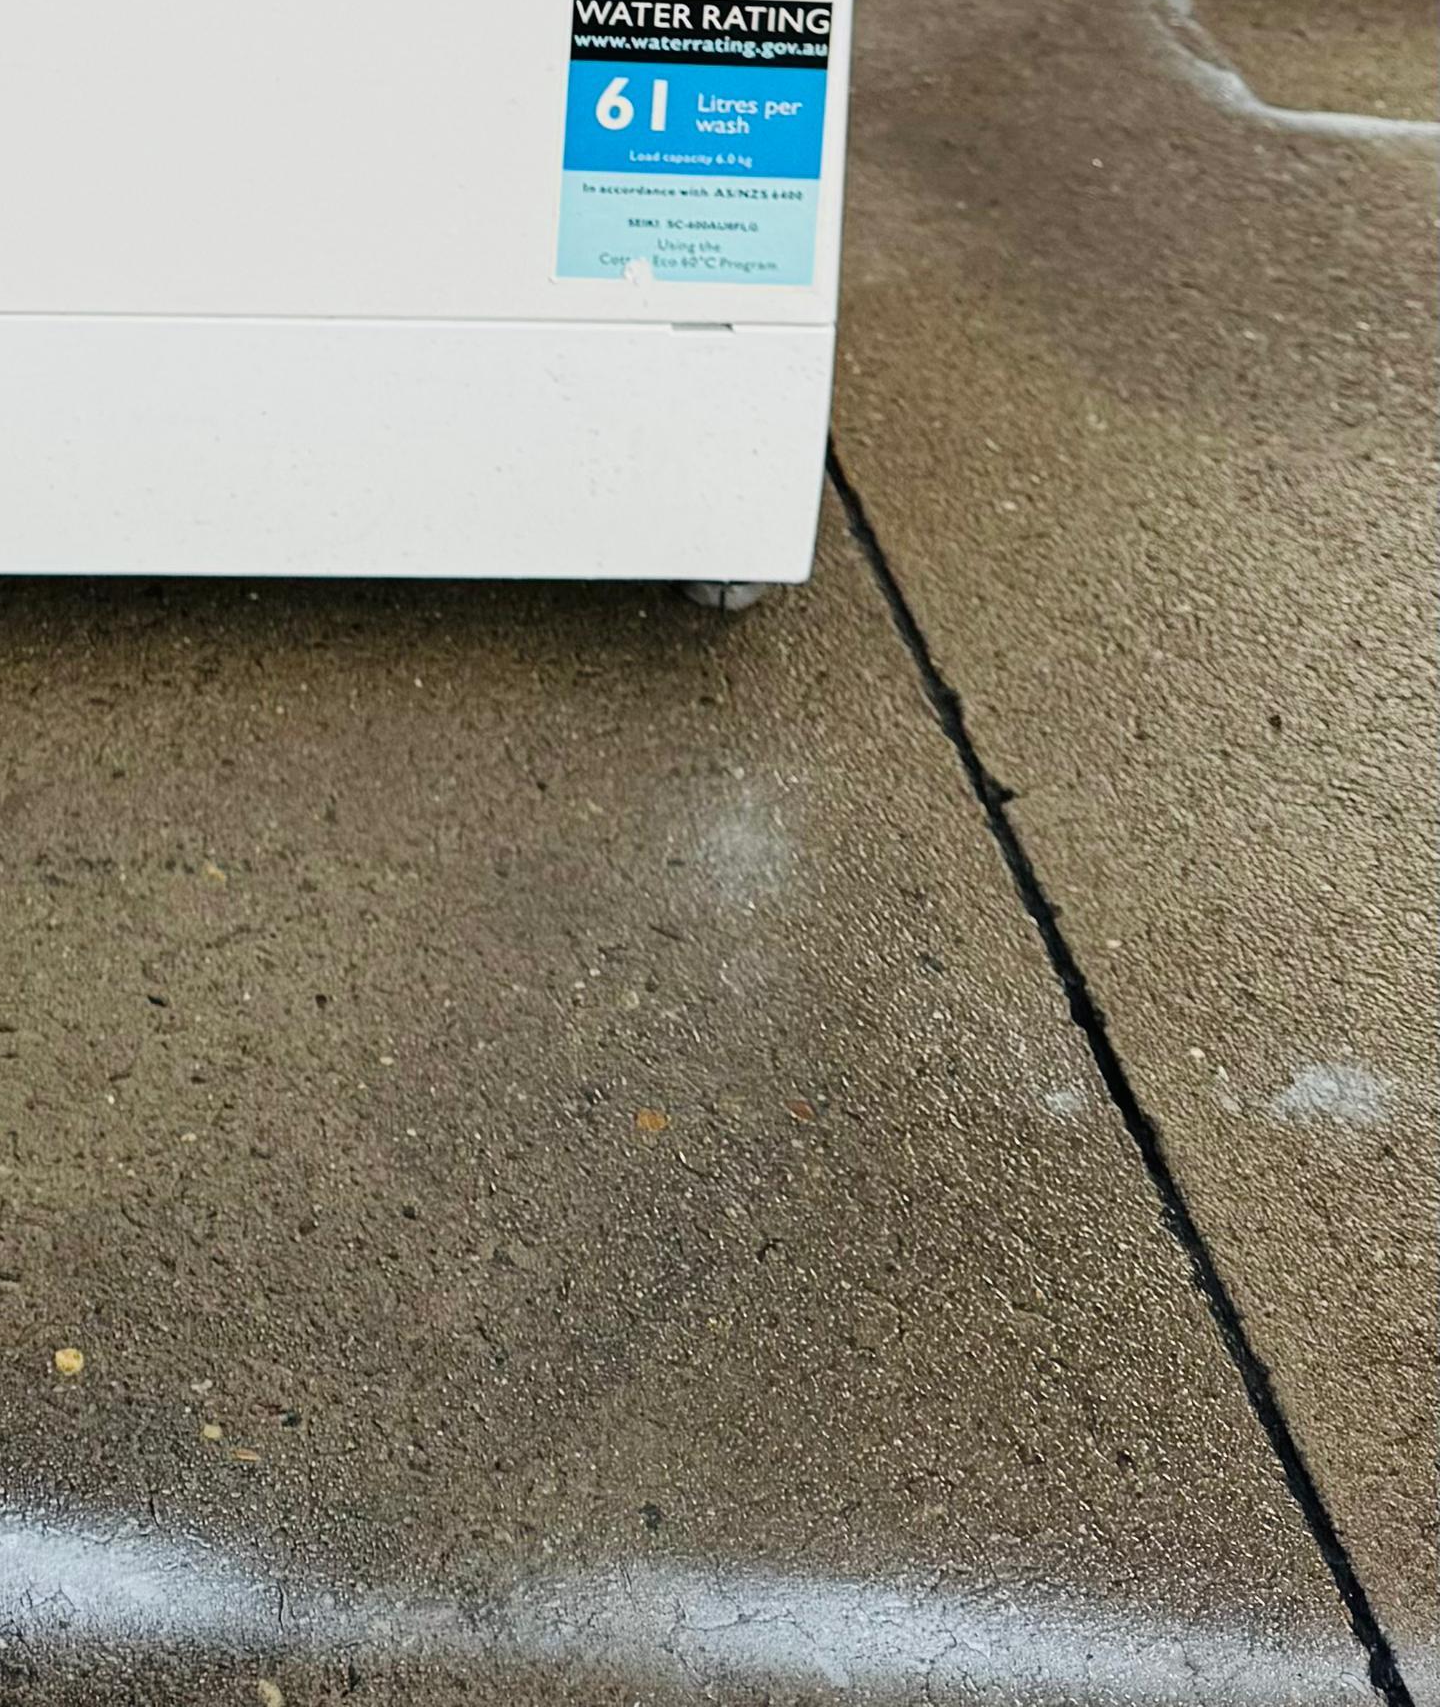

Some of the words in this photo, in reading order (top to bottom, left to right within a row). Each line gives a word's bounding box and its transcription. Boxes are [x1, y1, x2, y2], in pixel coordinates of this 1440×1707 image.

[701, 3, 831, 35] RATING
[573, 33, 829, 59] www.waterrating.gov.au
[595, 77, 669, 132] 61
[697, 92, 759, 115] Litres
[764, 100, 803, 120] per
[695, 115, 750, 135] wash
[629, 149, 660, 162] Load
[662, 153, 712, 166] capacity
[737, 154, 753, 170] kg
[657, 237, 695, 255] Using
[698, 240, 721, 253] the
[720, 256, 778, 273] Program
